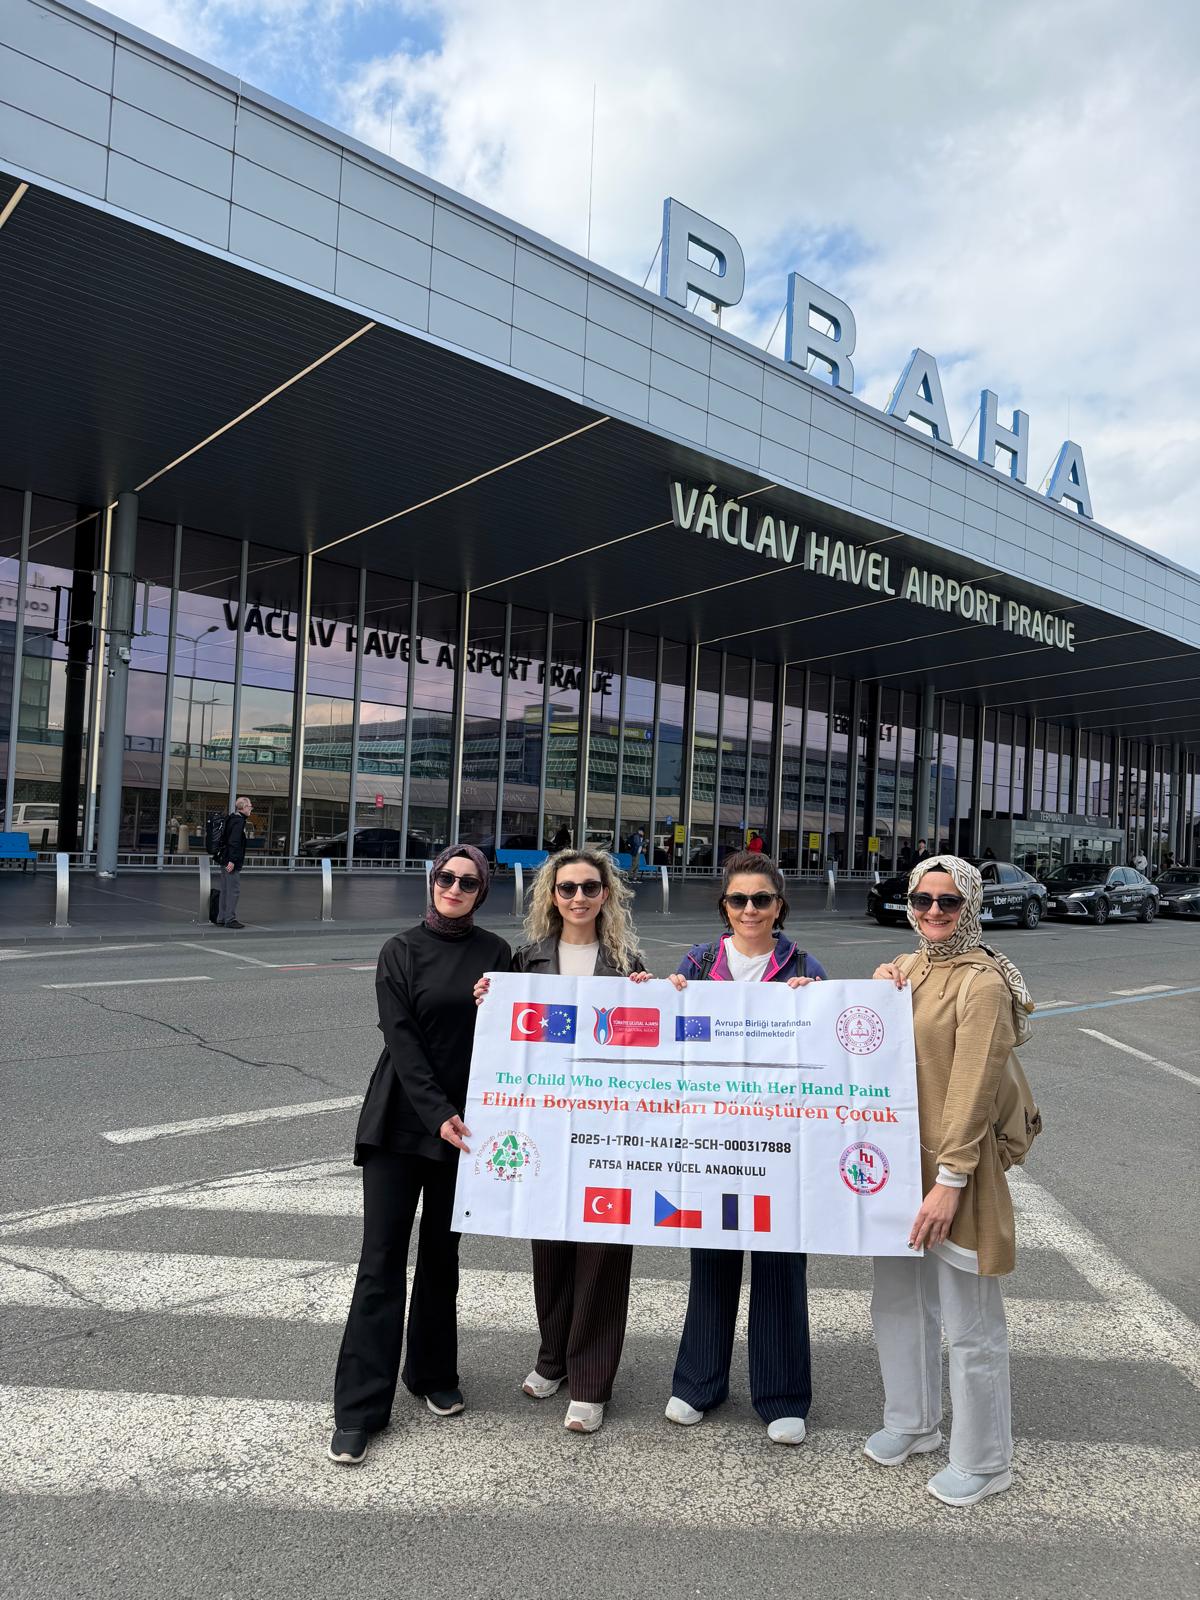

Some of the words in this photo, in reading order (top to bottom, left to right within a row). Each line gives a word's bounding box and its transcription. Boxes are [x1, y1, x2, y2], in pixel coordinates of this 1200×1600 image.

[660, 196, 1093, 520] PRAHA
[671, 481, 799, 563] VÁCLAV
[806, 531, 896, 596] HAVEL
[903, 566, 1001, 626] AIRPORT
[1005, 600, 1076, 652] PRAGUE
[436, 645, 532, 681] ARPORT
[993, 896, 1007, 905] Uber
[714, 1019, 743, 1028] Avrupa
[745, 1019, 769, 1029] Birliği
[771, 1020, 811, 1028] tarafından
[714, 1029, 744, 1037] finanse
[745, 1029, 796, 1038] edilmektedir
[496, 1072, 522, 1084] The
[527, 1073, 566, 1087] Child
[571, 1075, 603, 1088] Who
[608, 1077, 672, 1092] Recycles
[677, 1079, 720, 1092] Waste
[726, 1080, 762, 1094] With
[768, 1082, 797, 1095] Her
[801, 1082, 844, 1096] Hand
[849, 1084, 891, 1098] Paint
[481, 1091, 537, 1108] Elinin
[543, 1094, 629, 1114] Boyasıyla
[635, 1098, 707, 1115] Atıkları
[713, 1100, 829, 1121] Dönüştüren
[835, 1104, 899, 1125] Çocuk
[588, 1158, 622, 1170] FATSA
[626, 1160, 663, 1172] HACER
[667, 1160, 701, 1174] YÜCEL
[705, 1164, 767, 1177] ANAOKULU
